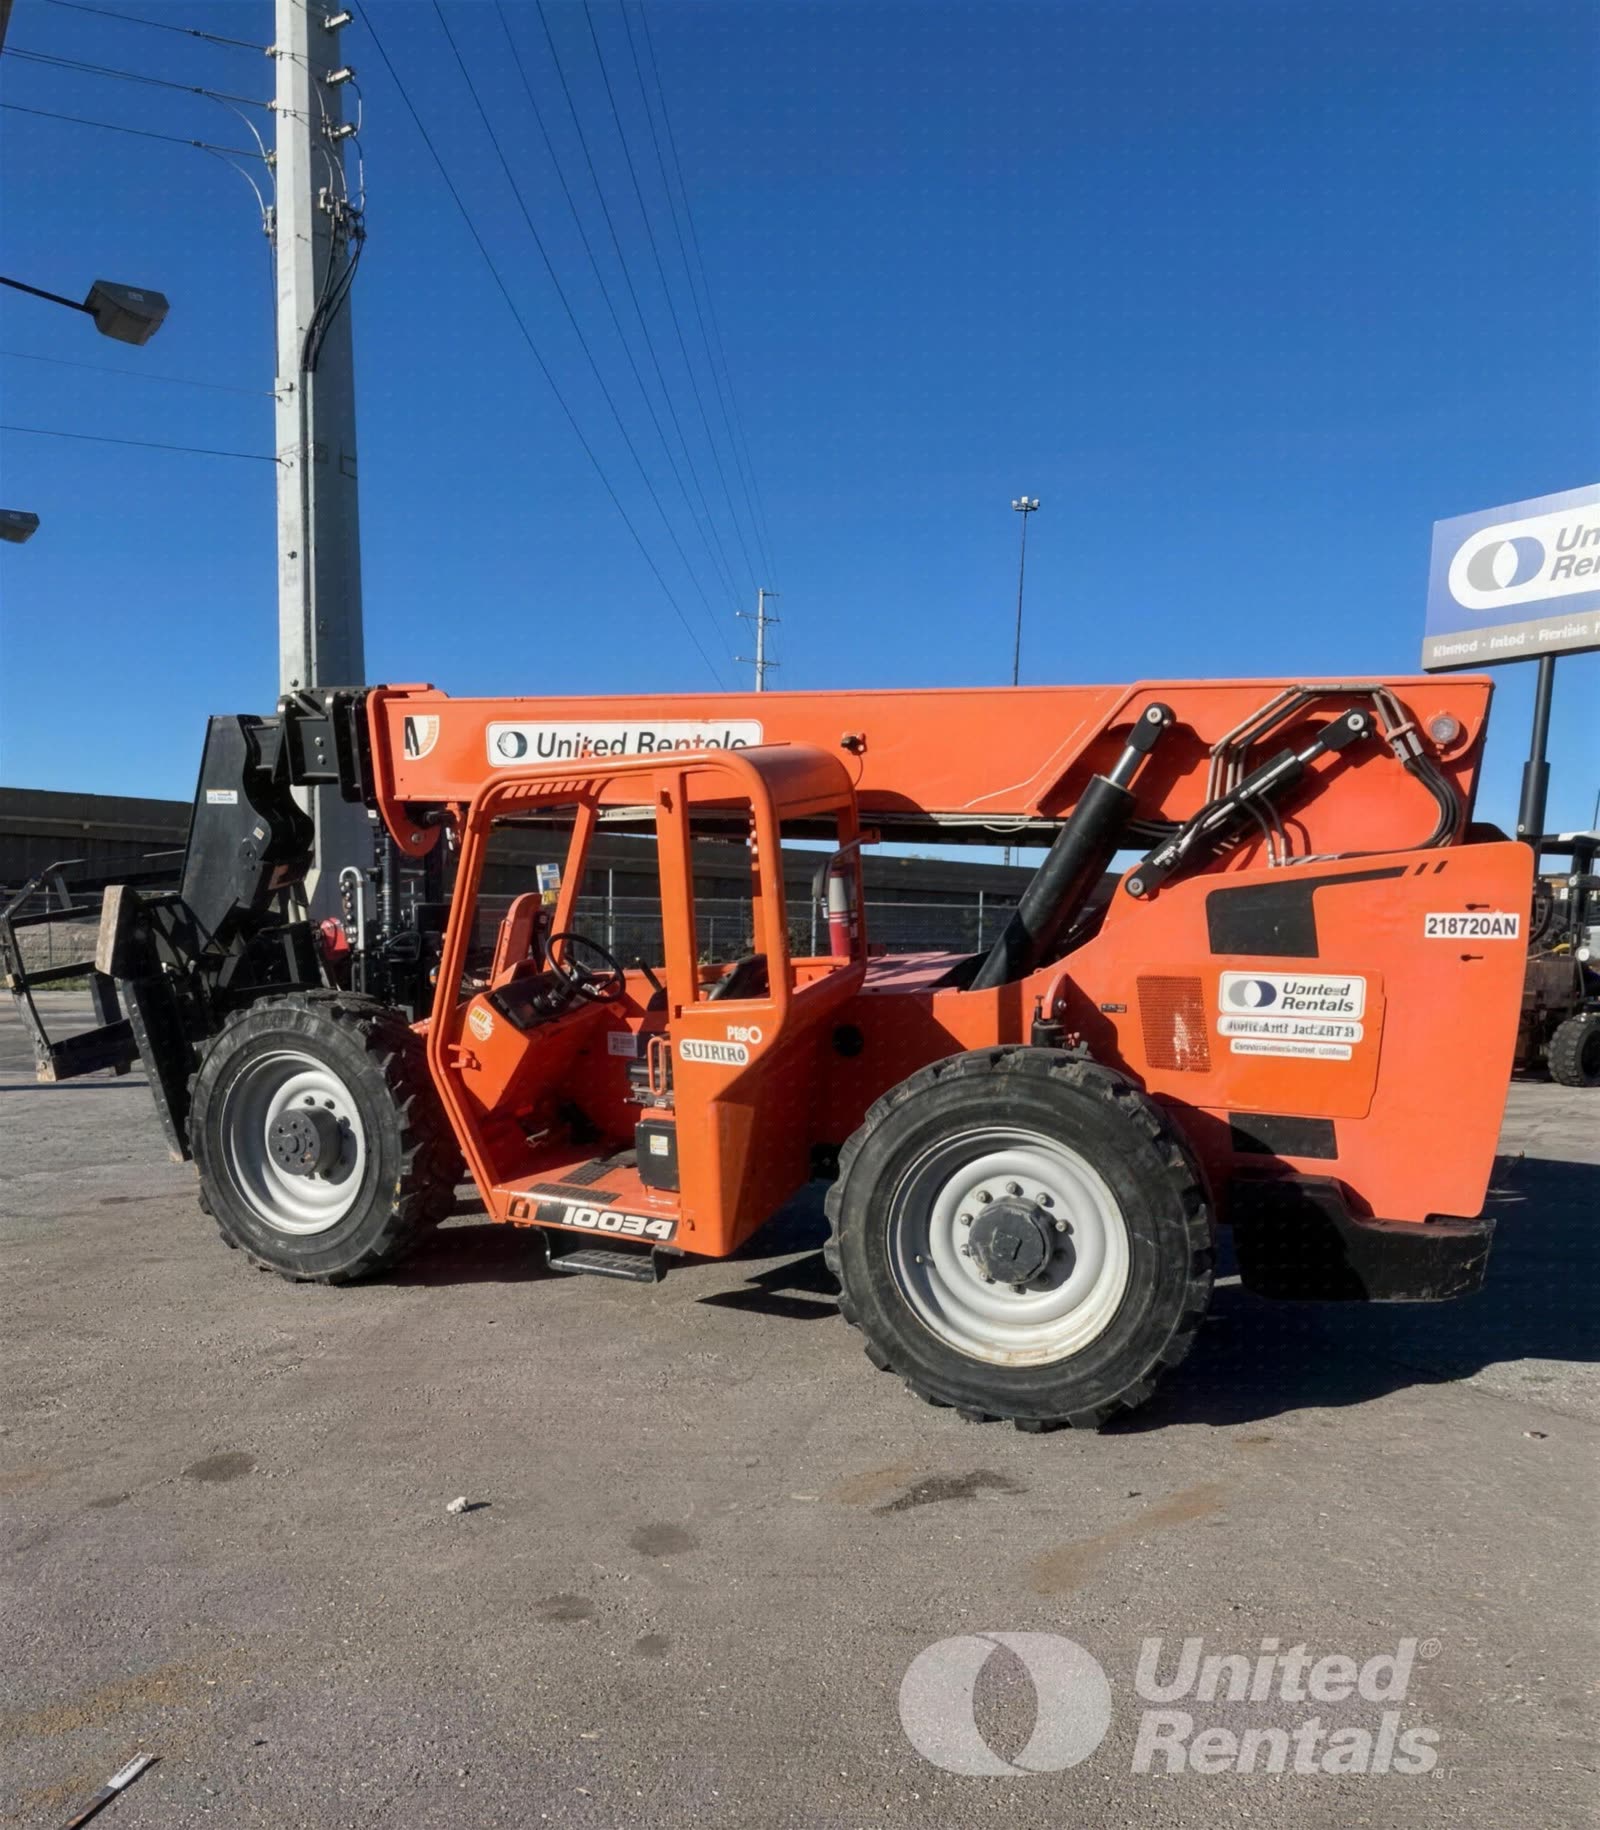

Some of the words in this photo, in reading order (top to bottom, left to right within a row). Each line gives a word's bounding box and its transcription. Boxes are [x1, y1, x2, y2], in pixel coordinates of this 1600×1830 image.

[1427, 917, 1517, 936] 218720AN
[1281, 997, 1354, 1012] Rentals
[562, 1206, 673, 1240] 10034
